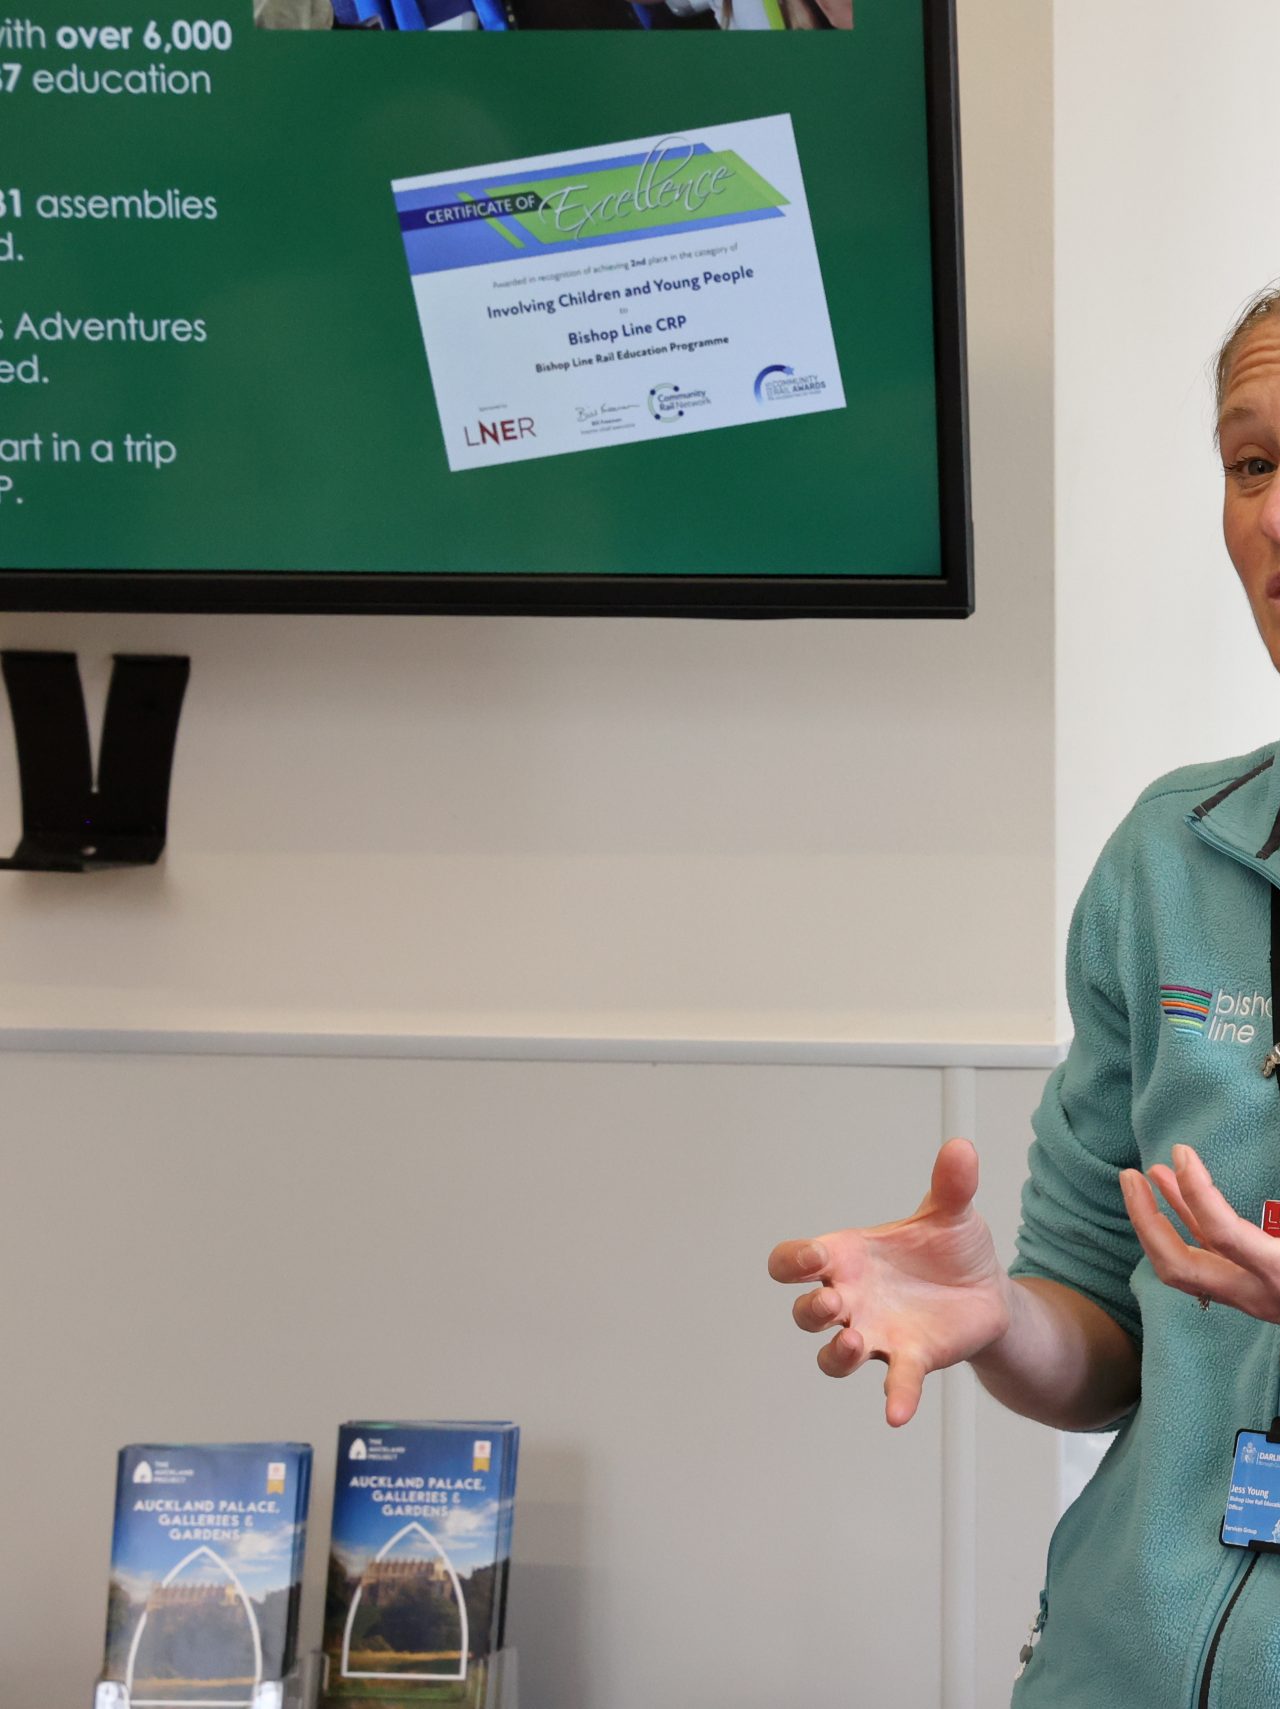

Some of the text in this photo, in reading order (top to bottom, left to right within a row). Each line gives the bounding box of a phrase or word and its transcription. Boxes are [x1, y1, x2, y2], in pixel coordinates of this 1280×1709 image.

[56, 26, 133, 49] over
[143, 19, 232, 53] 6,000
[33, 63, 211, 94] education
[425, 136, 736, 242] CERTIFICATE OF Excellence
[36, 188, 218, 219] assemblies
[538, 269, 581, 283] recognition
[584, 266, 591, 275] of
[593, 261, 630, 274] achieving
[631, 258, 647, 268] 2nd
[648, 253, 669, 266] place
[671, 253, 678, 261] in
[679, 250, 693, 260] the
[694, 245, 729, 259] category
[487, 266, 754, 319] Involving Children and Young People
[14, 311, 207, 342] Adventures
[568, 314, 687, 346] Bishop Line CRP
[535, 335, 729, 373] Bishop Line Rail Education Programme
[657, 390, 706, 403] Community
[792, 380, 826, 393] AWARDS
[659, 398, 711, 412] Rail Network
[464, 417, 536, 447] LNER
[52, 432, 80, 462] in
[90, 440, 113, 463] a
[124, 433, 177, 469] trip
[1208, 1016, 1255, 1043] line
[350, 1476, 486, 1491] AUCKLAND PALACE,
[372, 1490, 461, 1504] GALLERIES &
[1231, 1485, 1269, 1499] Jess Young
[134, 1500, 280, 1514] AUCKLAND PALACE,
[158, 1514, 240, 1527] GALLERIES
[381, 1504, 449, 1517] GARDENS
[169, 1528, 241, 1541] GARDENS
